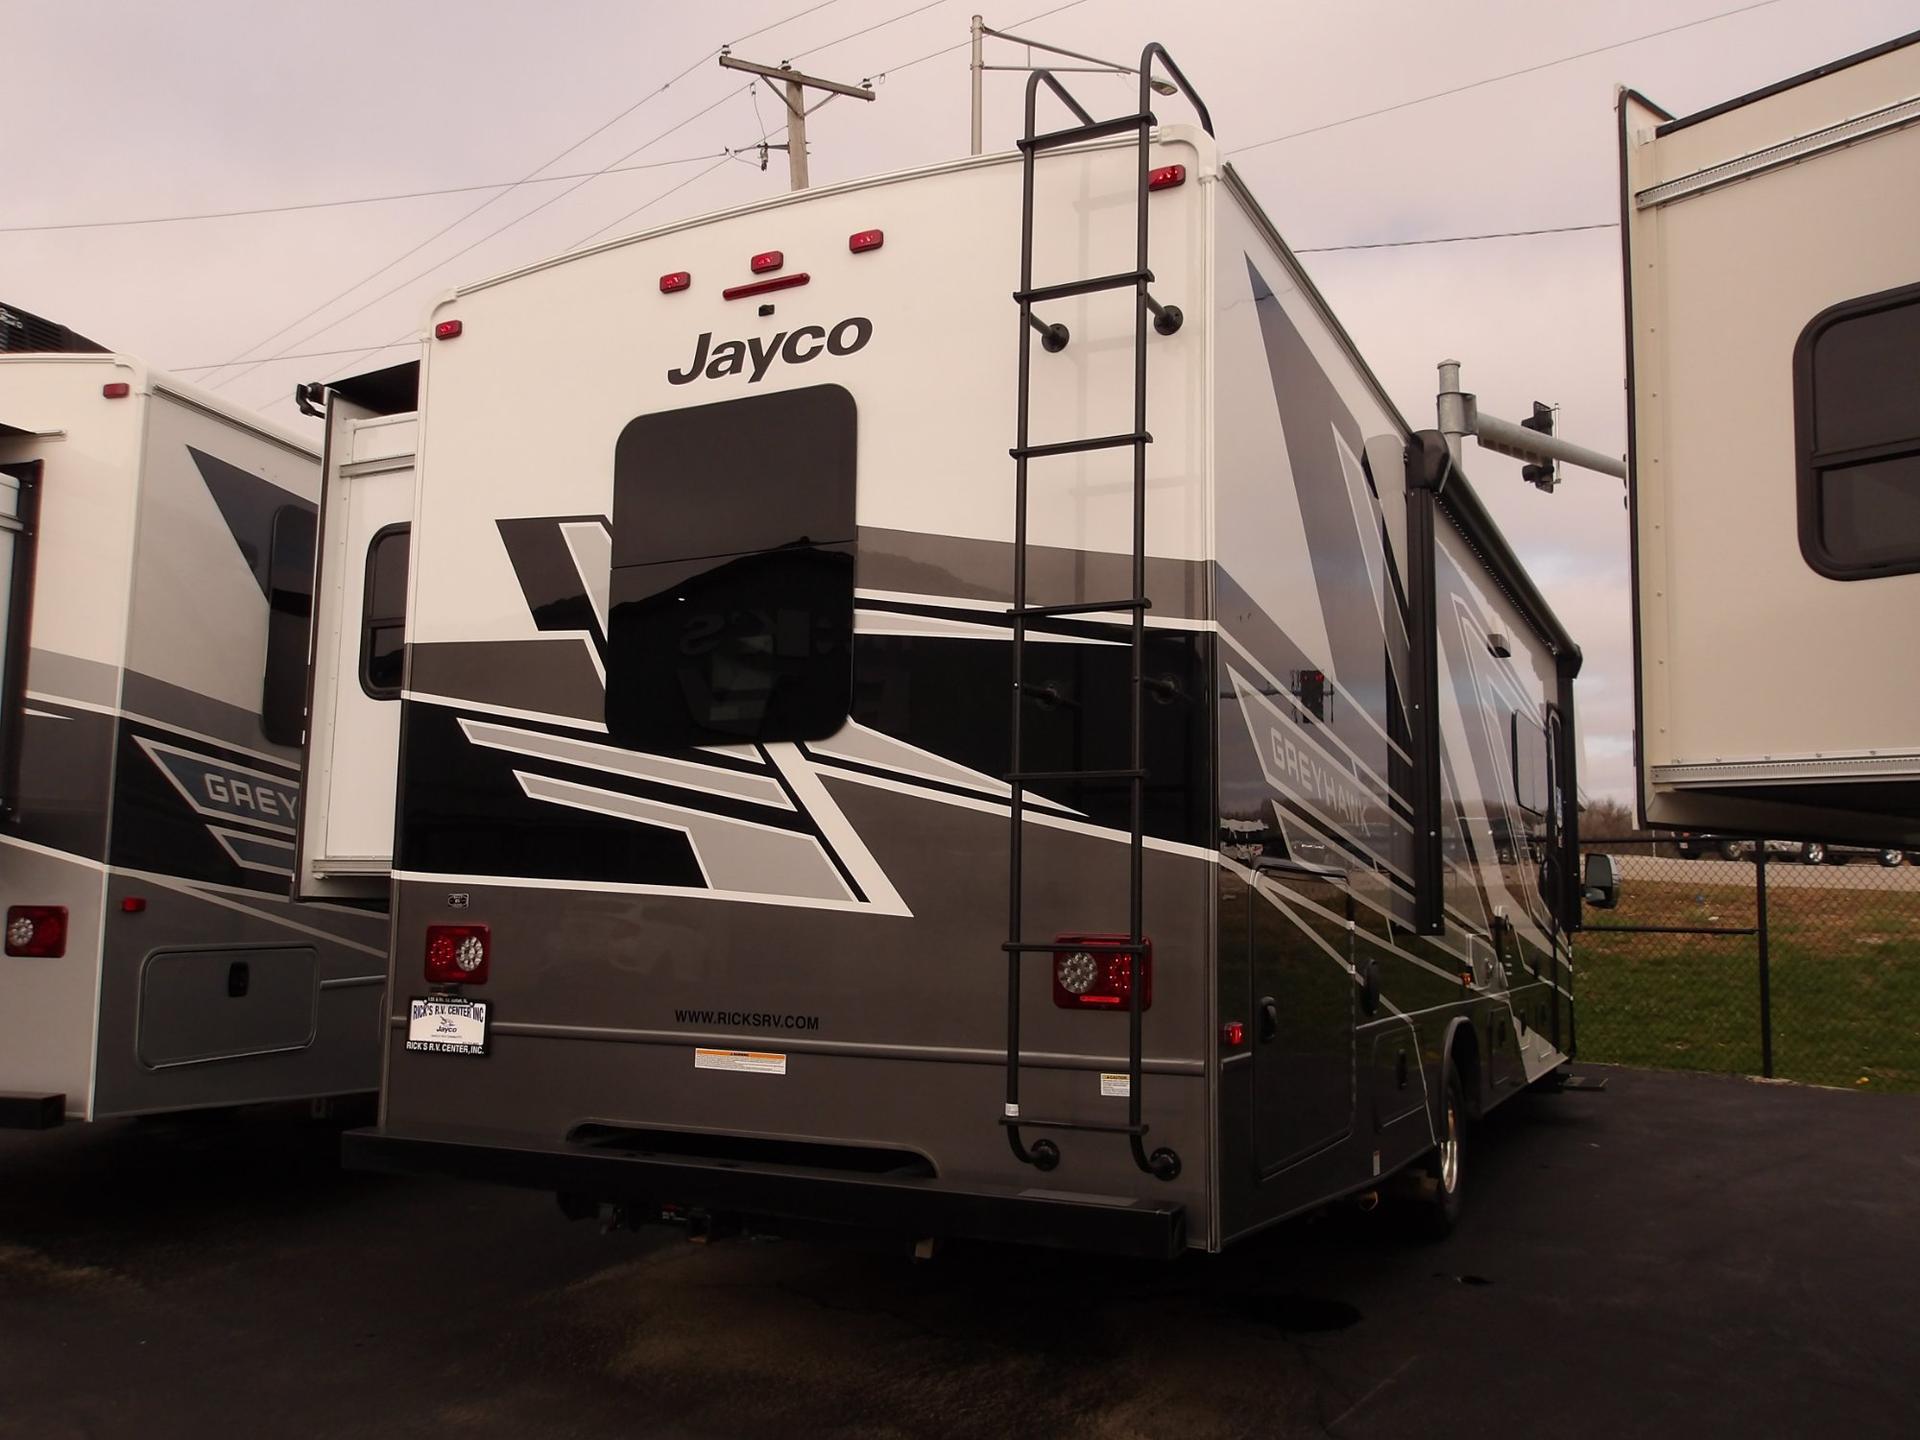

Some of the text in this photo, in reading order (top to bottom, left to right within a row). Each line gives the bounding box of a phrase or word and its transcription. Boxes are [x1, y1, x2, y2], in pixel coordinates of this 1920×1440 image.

[667, 316, 873, 385] Jayco
[1270, 726, 1371, 837] GREYHAWK
[447, 1006, 472, 1018] CENTER
[674, 1009, 819, 1030] WWW.RICKSRV.COM
[436, 1026, 457, 1034] Jayco
